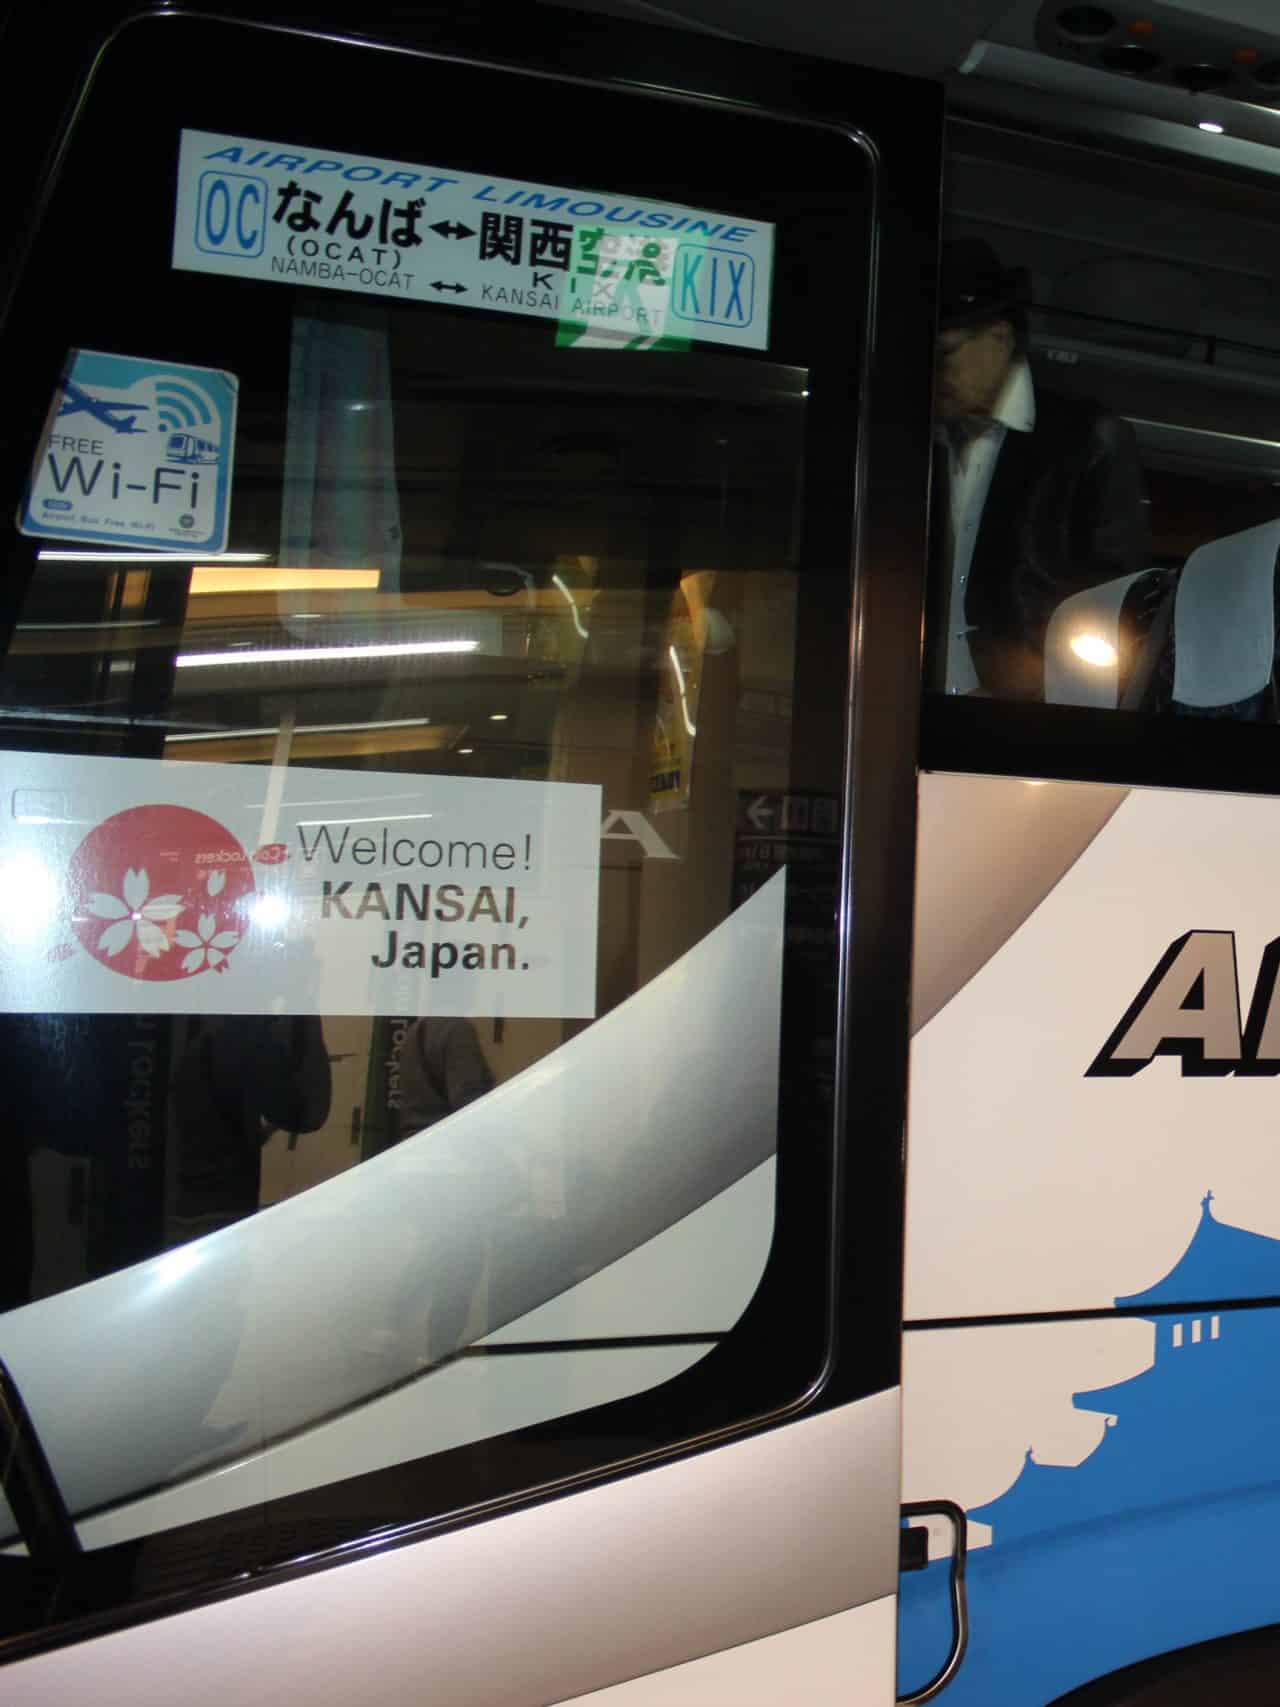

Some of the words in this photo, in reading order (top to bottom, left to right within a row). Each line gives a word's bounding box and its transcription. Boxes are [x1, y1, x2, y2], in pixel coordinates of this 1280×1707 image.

[203, 145, 459, 194] AIRPORT
[473, 184, 760, 244] LIMOUSINE
[204, 178, 261, 250] OC
[272, 180, 427, 248] なんば
[287, 237, 402, 269] (OCAT)
[271, 255, 416, 292] NAMBA-OCAT
[481, 283, 560, 311] KANSAI
[571, 296, 663, 324] AIRPORT
[681, 252, 746, 321] KIX
[47, 433, 104, 456] FREE
[48, 453, 200, 509] Wi-Fi
[298, 824, 532, 872] Welcome!
[320, 880, 529, 930] KANSAI,
[371, 930, 530, 979] Japan.
